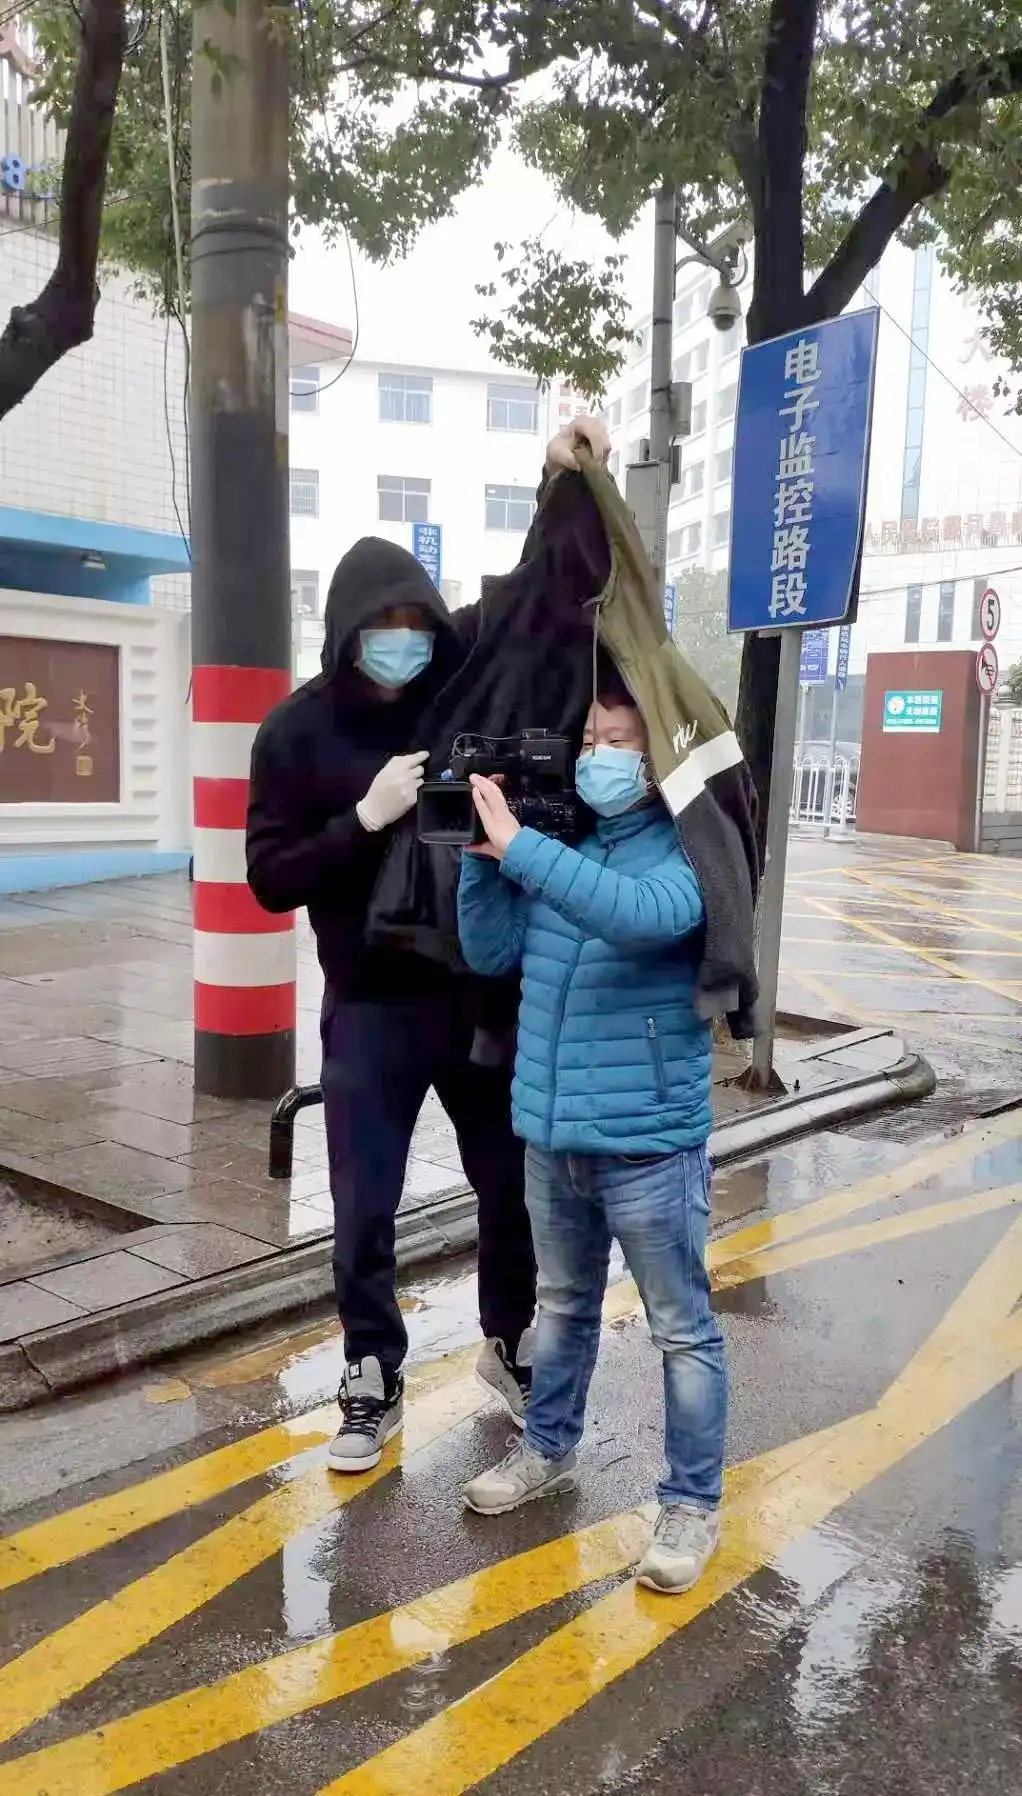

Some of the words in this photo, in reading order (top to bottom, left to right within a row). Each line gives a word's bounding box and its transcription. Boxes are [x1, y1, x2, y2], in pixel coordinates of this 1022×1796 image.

[768, 339, 822, 619] 电子监控路段
[986, 598, 995, 631] 5
